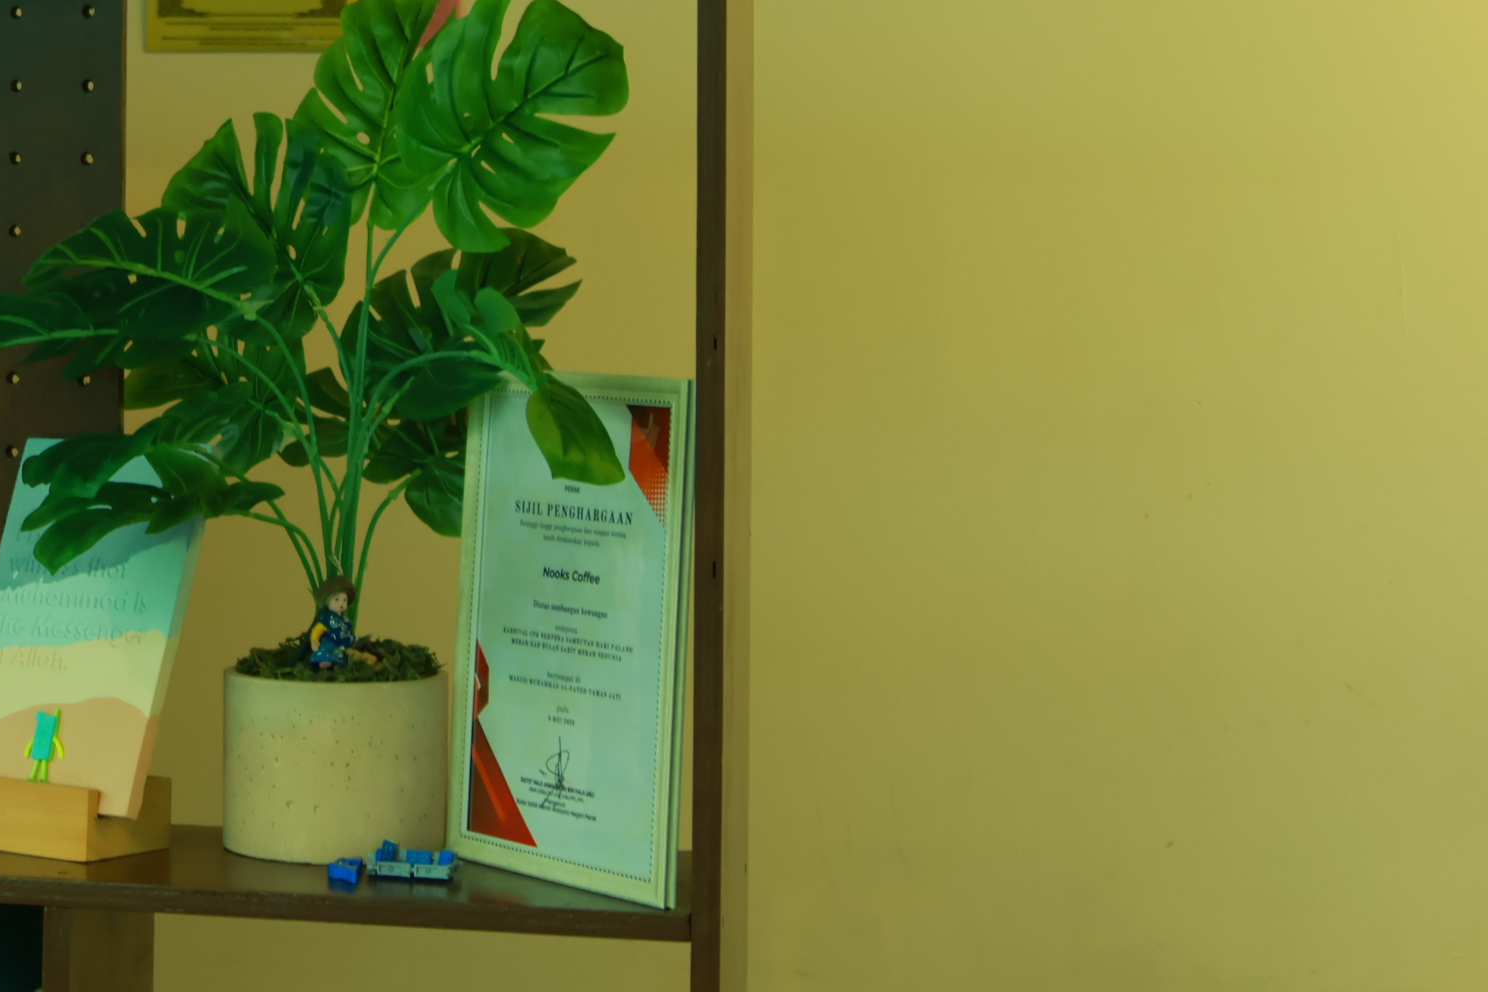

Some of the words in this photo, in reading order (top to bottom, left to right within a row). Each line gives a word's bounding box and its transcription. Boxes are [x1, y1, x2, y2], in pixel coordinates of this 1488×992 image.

[514, 500, 543, 516] SIJIL
[546, 502, 633, 526] PENGHARGAAN
[542, 566, 570, 581] Nooks
[571, 569, 601, 585] Coffee
[31, 615, 143, 648] Messenger
